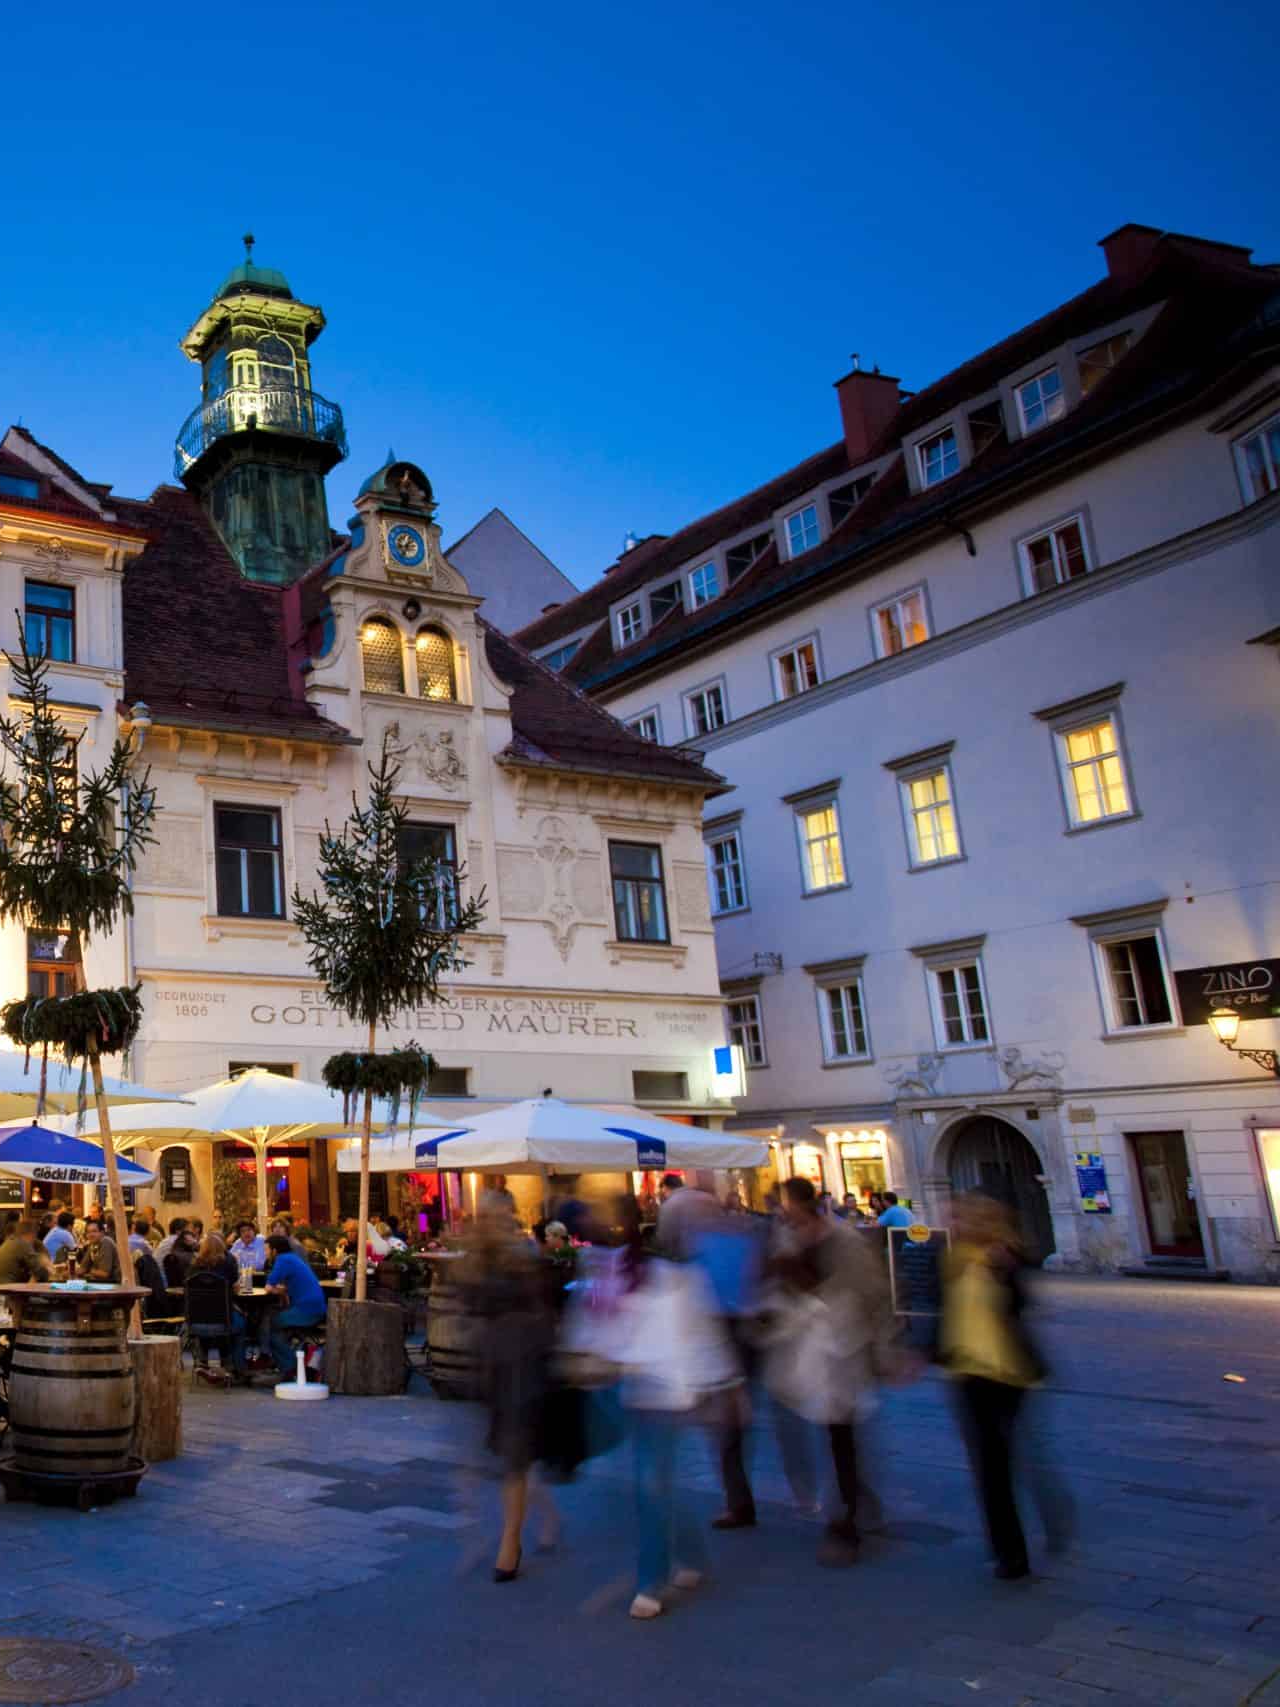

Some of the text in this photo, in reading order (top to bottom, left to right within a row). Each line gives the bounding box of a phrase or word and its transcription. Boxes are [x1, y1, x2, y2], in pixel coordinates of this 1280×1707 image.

[1202, 966, 1273, 995] ZINO
[32, 1165, 96, 1182] Glöckl Bräu
